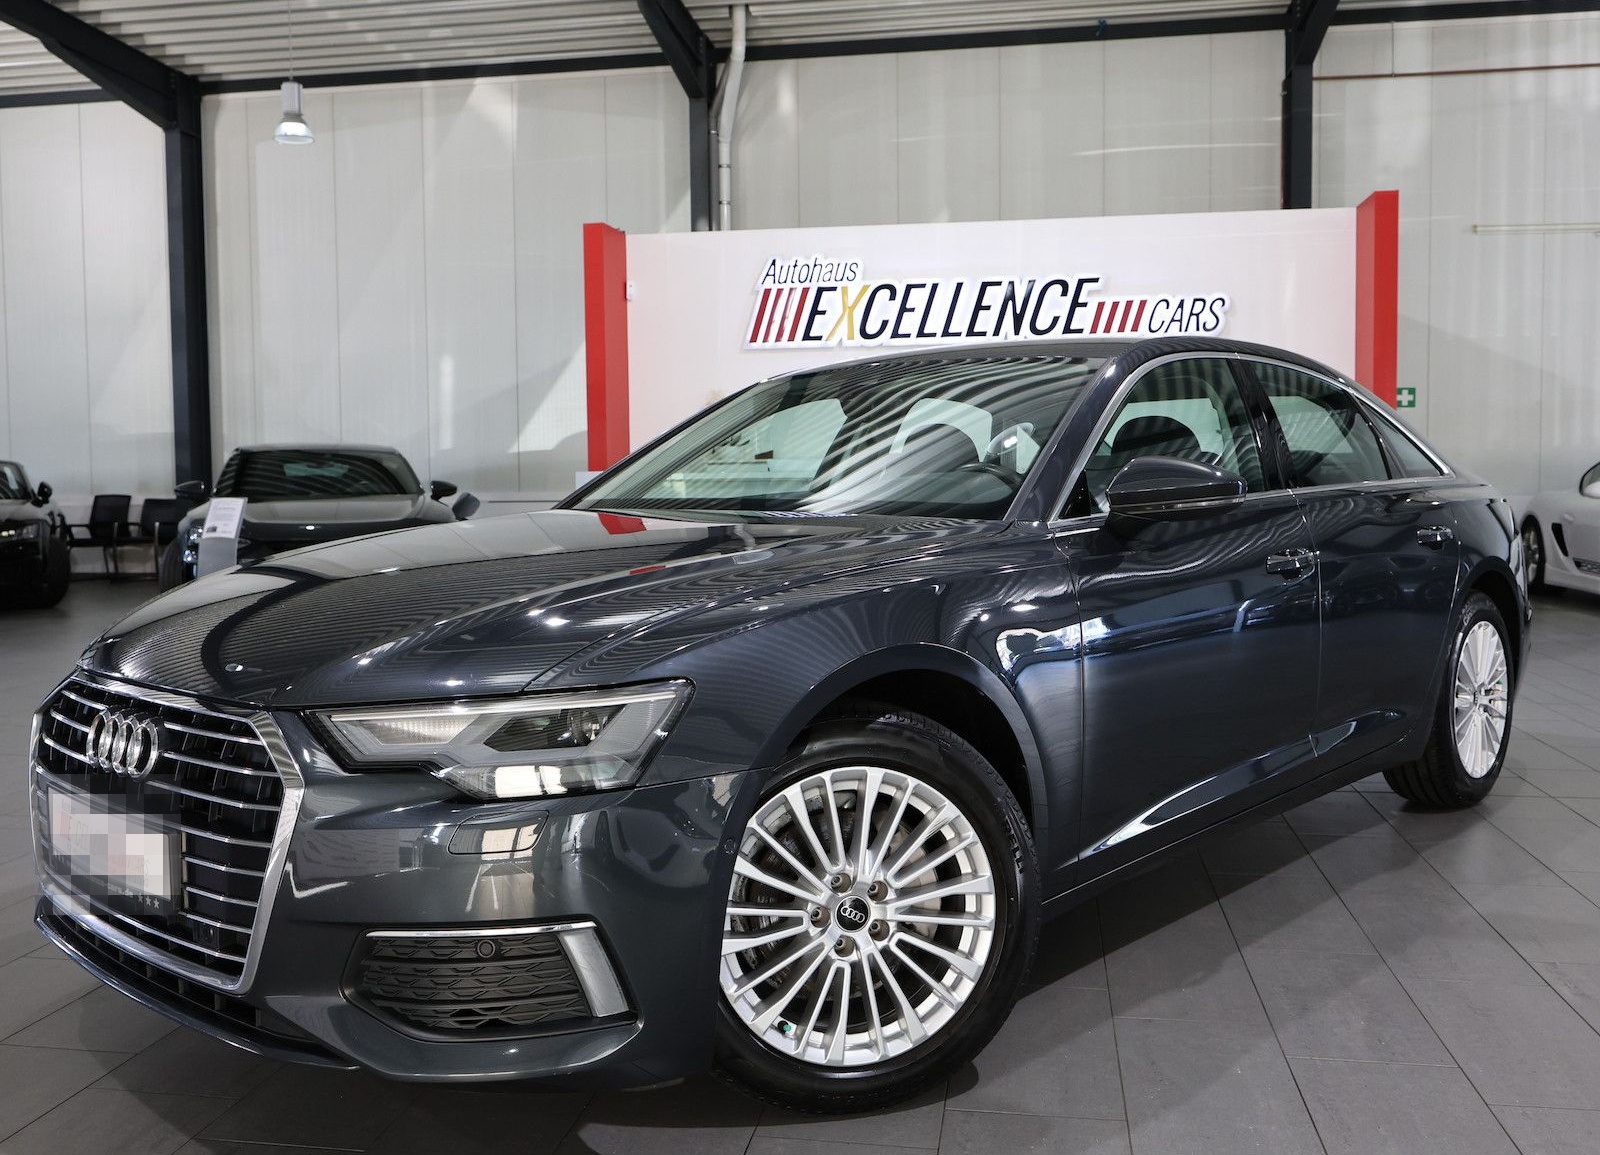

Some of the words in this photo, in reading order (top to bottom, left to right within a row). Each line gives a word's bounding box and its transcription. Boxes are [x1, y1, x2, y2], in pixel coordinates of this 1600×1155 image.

[761, 257, 859, 285] Autohaus
[801, 277, 1100, 342] EXCELLENCE
[1148, 297, 1226, 334] CARS
